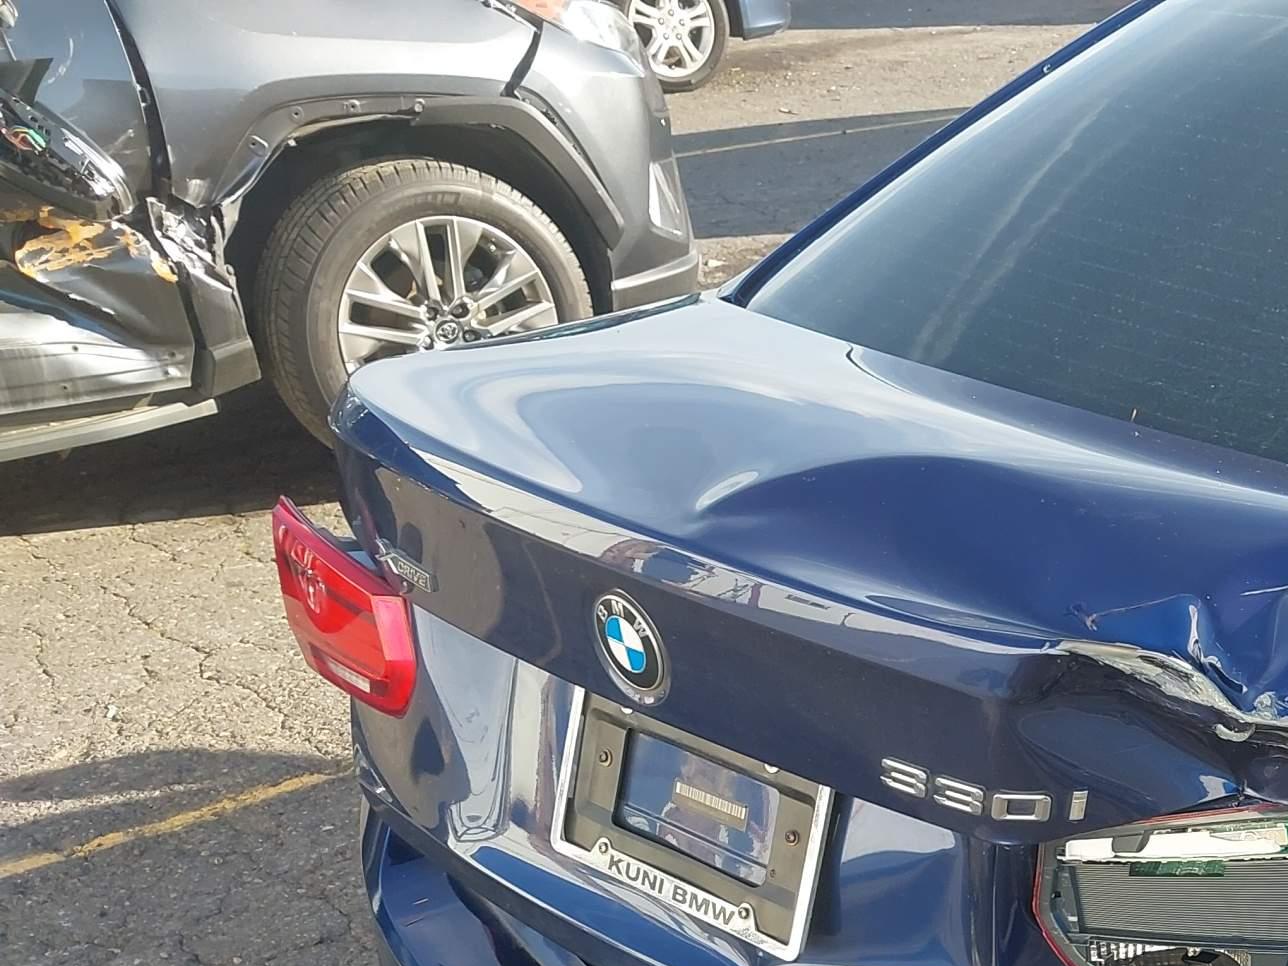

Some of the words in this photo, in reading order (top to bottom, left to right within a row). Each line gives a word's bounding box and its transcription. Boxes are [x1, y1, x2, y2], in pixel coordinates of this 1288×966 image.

[597, 599, 650, 638] BMW
[607, 854, 665, 895] KUNI
[671, 883, 736, 926] BMW
